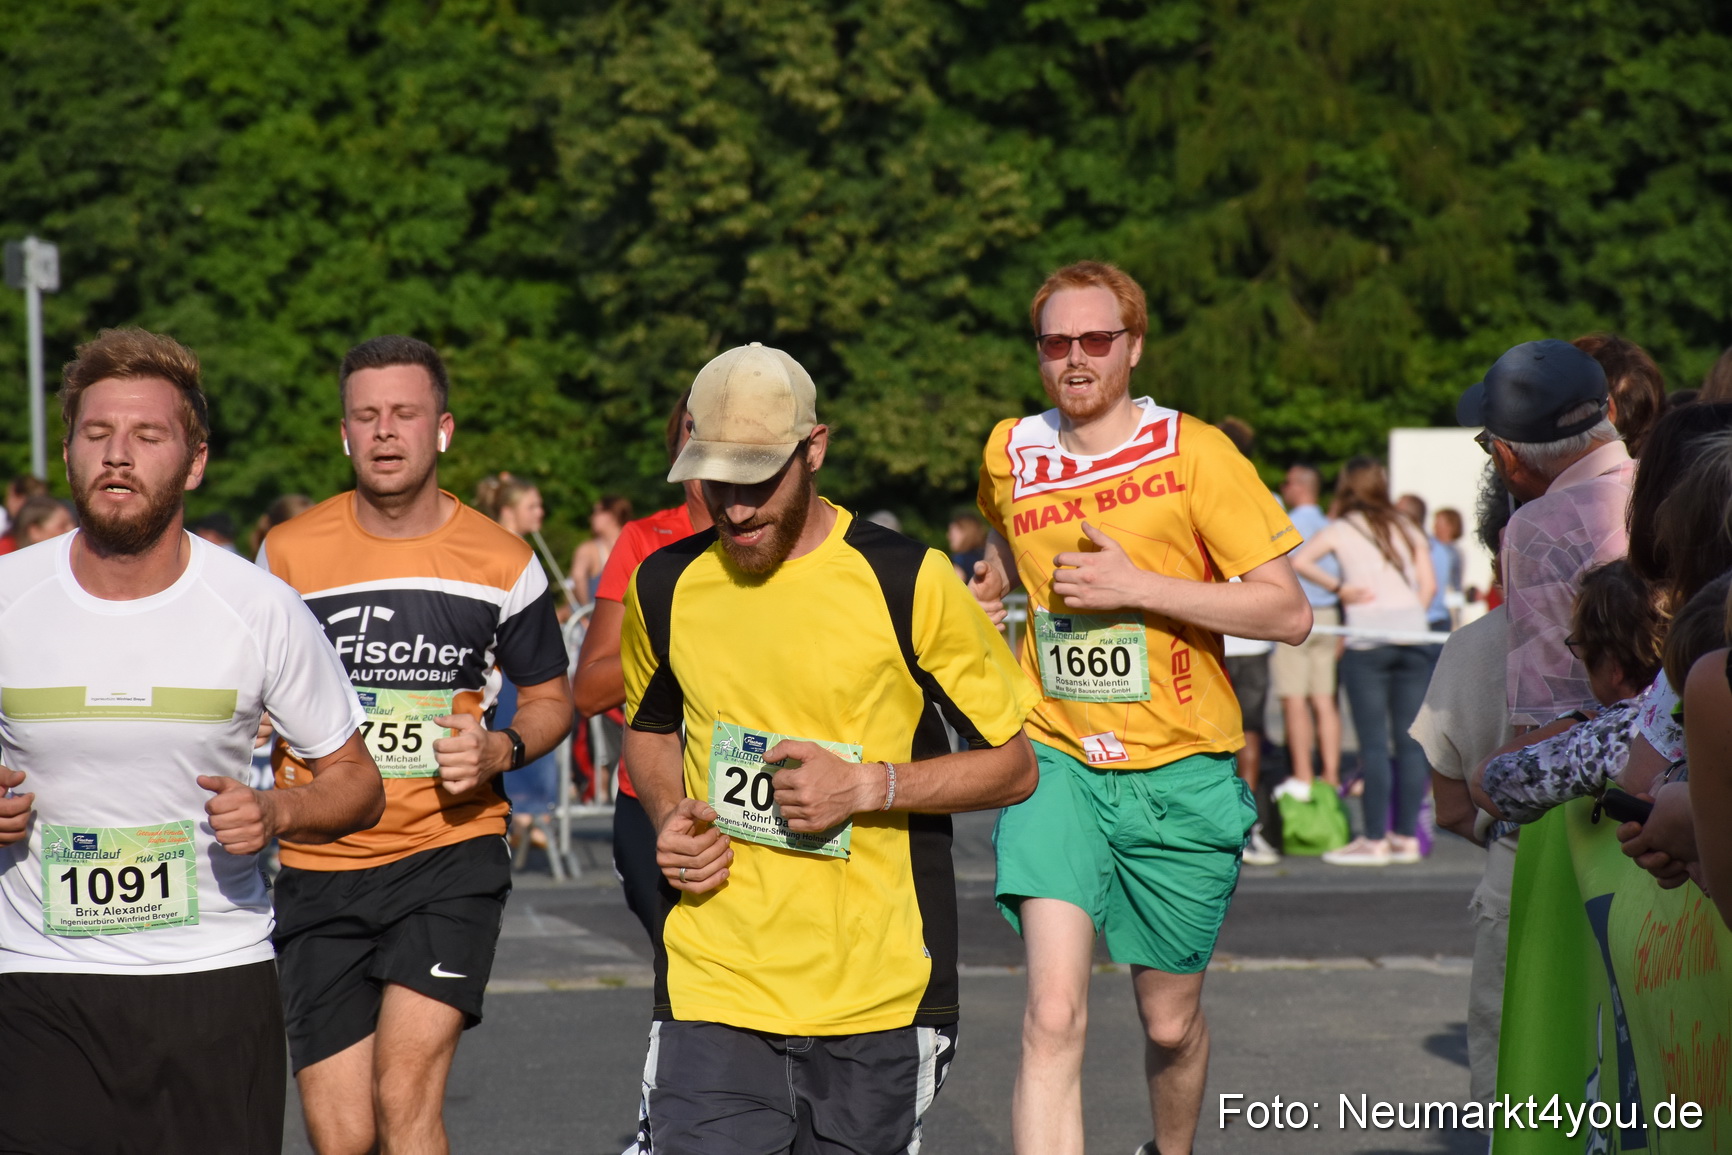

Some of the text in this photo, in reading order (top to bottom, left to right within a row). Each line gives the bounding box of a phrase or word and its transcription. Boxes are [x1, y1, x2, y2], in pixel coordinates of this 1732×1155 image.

[1013, 497, 1087, 537] MAX
[1094, 470, 1187, 513] BÖGL
[1116, 637, 1138, 645] 2019
[335, 634, 473, 666] Fischer
[1049, 645, 1131, 678] 1660
[1055, 676, 1129, 687] Rosanski Valentin
[362, 707, 395, 715] enlauf
[374, 754, 421, 763] bl Michael
[723, 766, 774, 812] 20
[743, 810, 788, 828] Röhrl Da
[717, 815, 801, 840] Regens-Wagner-Stiftung
[802, 833, 839, 845] Holnstein
[63, 848, 122, 860] firmenlauf
[158, 849, 185, 861] 2019
[61, 862, 170, 905] 1091
[75, 903, 163, 917] Brix Alexander
[60, 916, 115, 927] Ingenieurbüro
[117, 915, 150, 924] Winfried
[152, 911, 178, 921] Breyer
